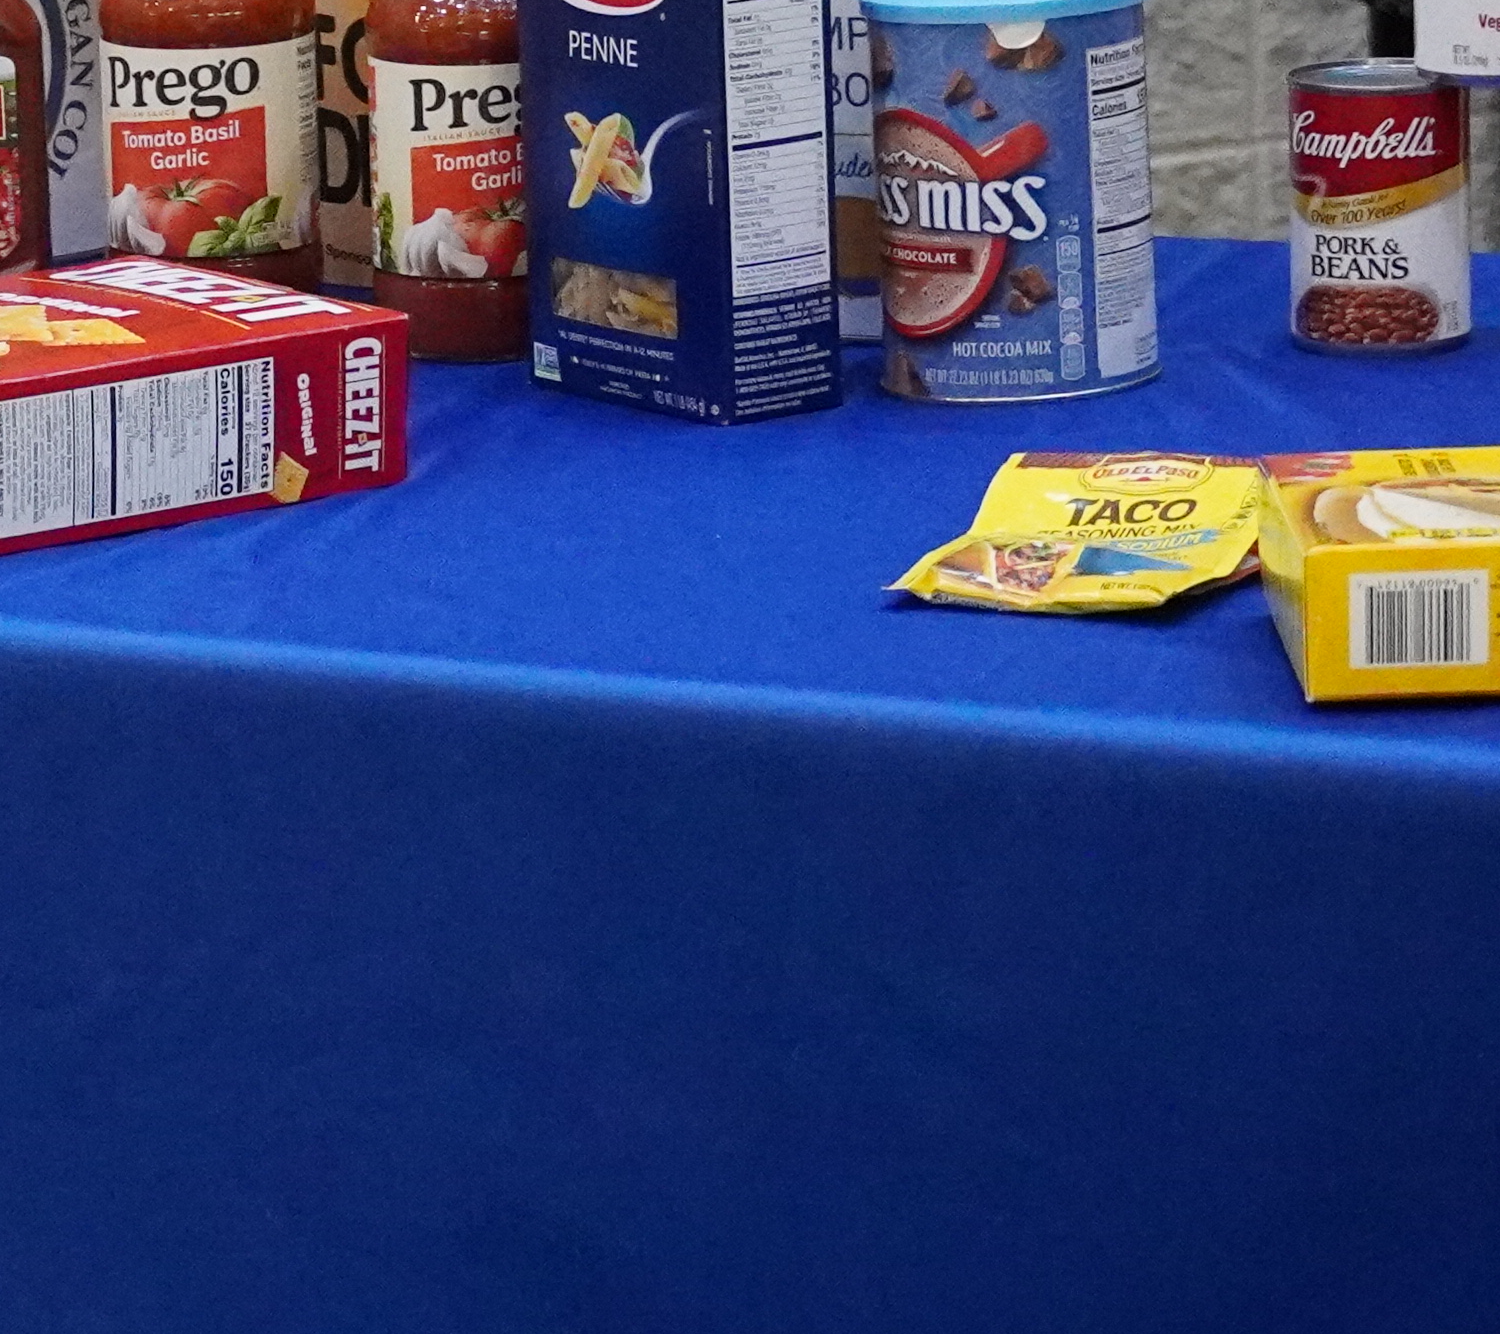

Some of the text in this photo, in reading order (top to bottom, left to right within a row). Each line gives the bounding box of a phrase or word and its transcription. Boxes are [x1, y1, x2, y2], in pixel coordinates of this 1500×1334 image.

[569, 30, 638, 67] PENNE
[1090, 46, 1128, 66] Nutrition
[108, 55, 260, 119] Prego
[122, 120, 241, 149] Tomato Basil
[1292, 111, 1437, 168] Campbell's
[150, 149, 210, 170] Garlic
[433, 152, 510, 173] Tomato
[894, 248, 957, 265] CHOCOLATE
[1315, 234, 1400, 255] PORK &
[1311, 254, 1409, 280] BEANS
[953, 340, 1052, 358] HOT COCOA MIX
[220, 368, 233, 496] Calories 150
[259, 360, 272, 490] Nutrition Facts
[1066, 499, 1198, 527] TACO
[1118, 532, 1202, 553] SODIUM
